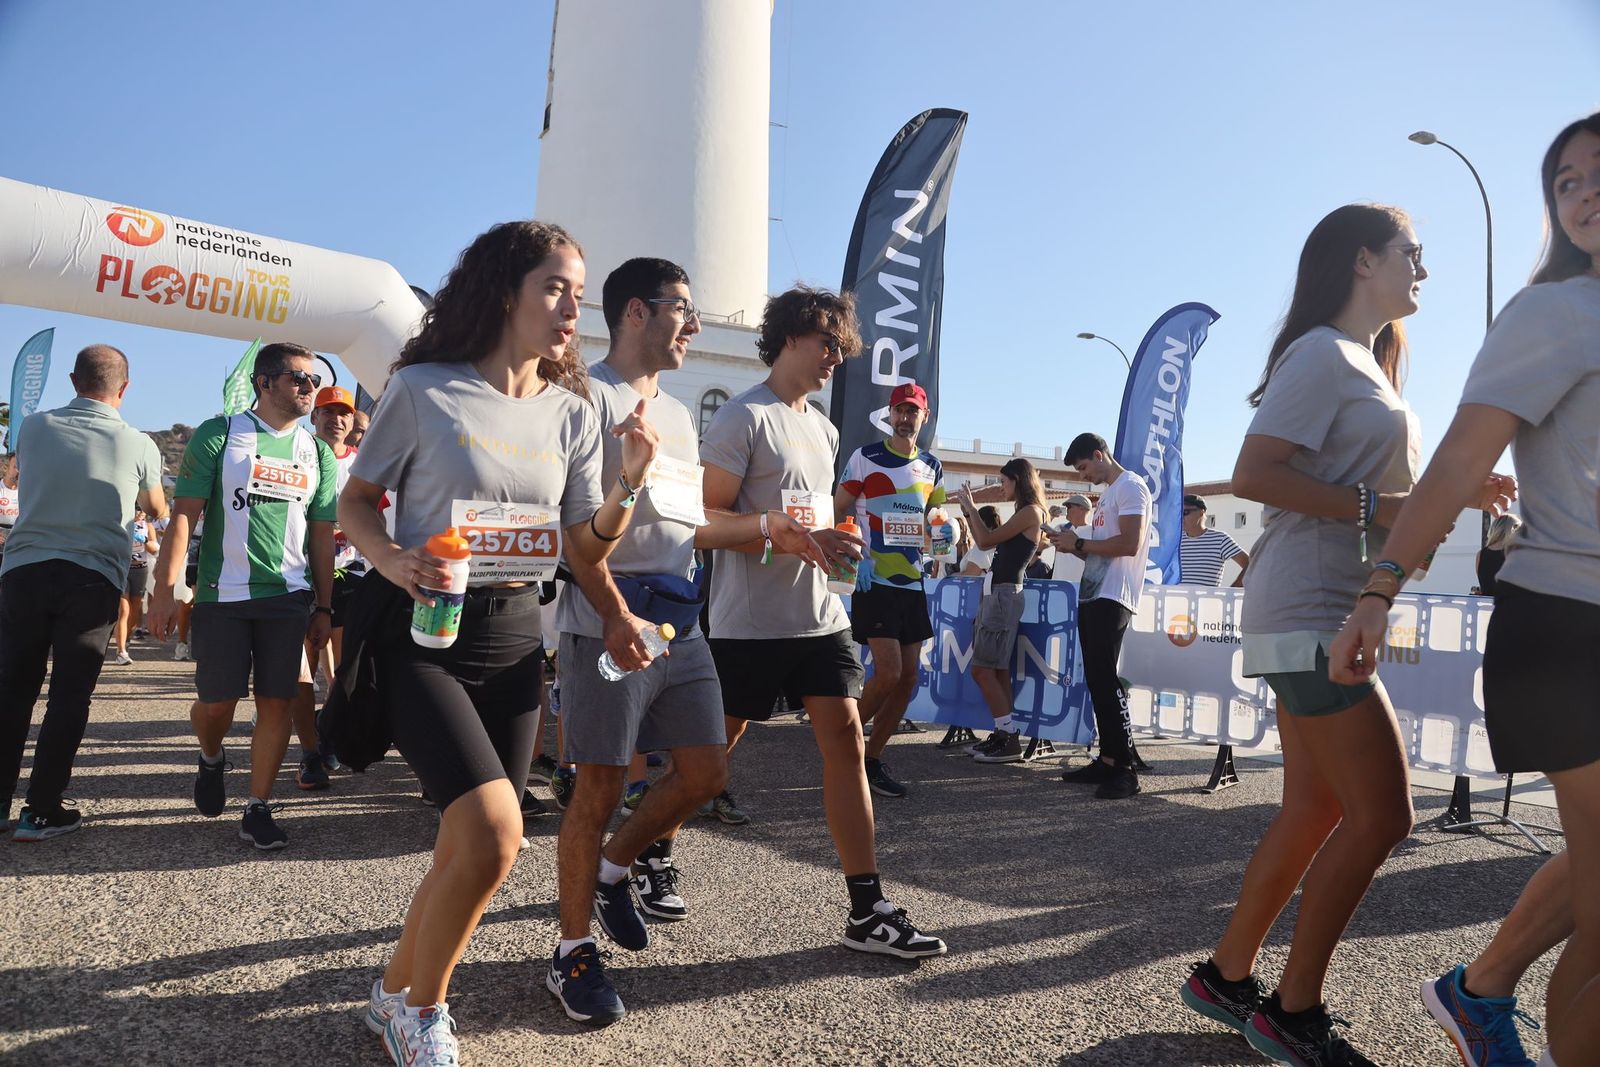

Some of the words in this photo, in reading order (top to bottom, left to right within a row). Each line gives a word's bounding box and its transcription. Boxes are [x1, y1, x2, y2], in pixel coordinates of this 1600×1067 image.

[176, 222, 262, 247] nationale
[176, 234, 292, 267] nederlanden
[96, 254, 290, 325] PLOGGING
[246, 267, 291, 288] TOUR
[260, 467, 303, 486] 25167
[466, 529, 552, 553] 25764
[889, 524, 919, 535] 25183
